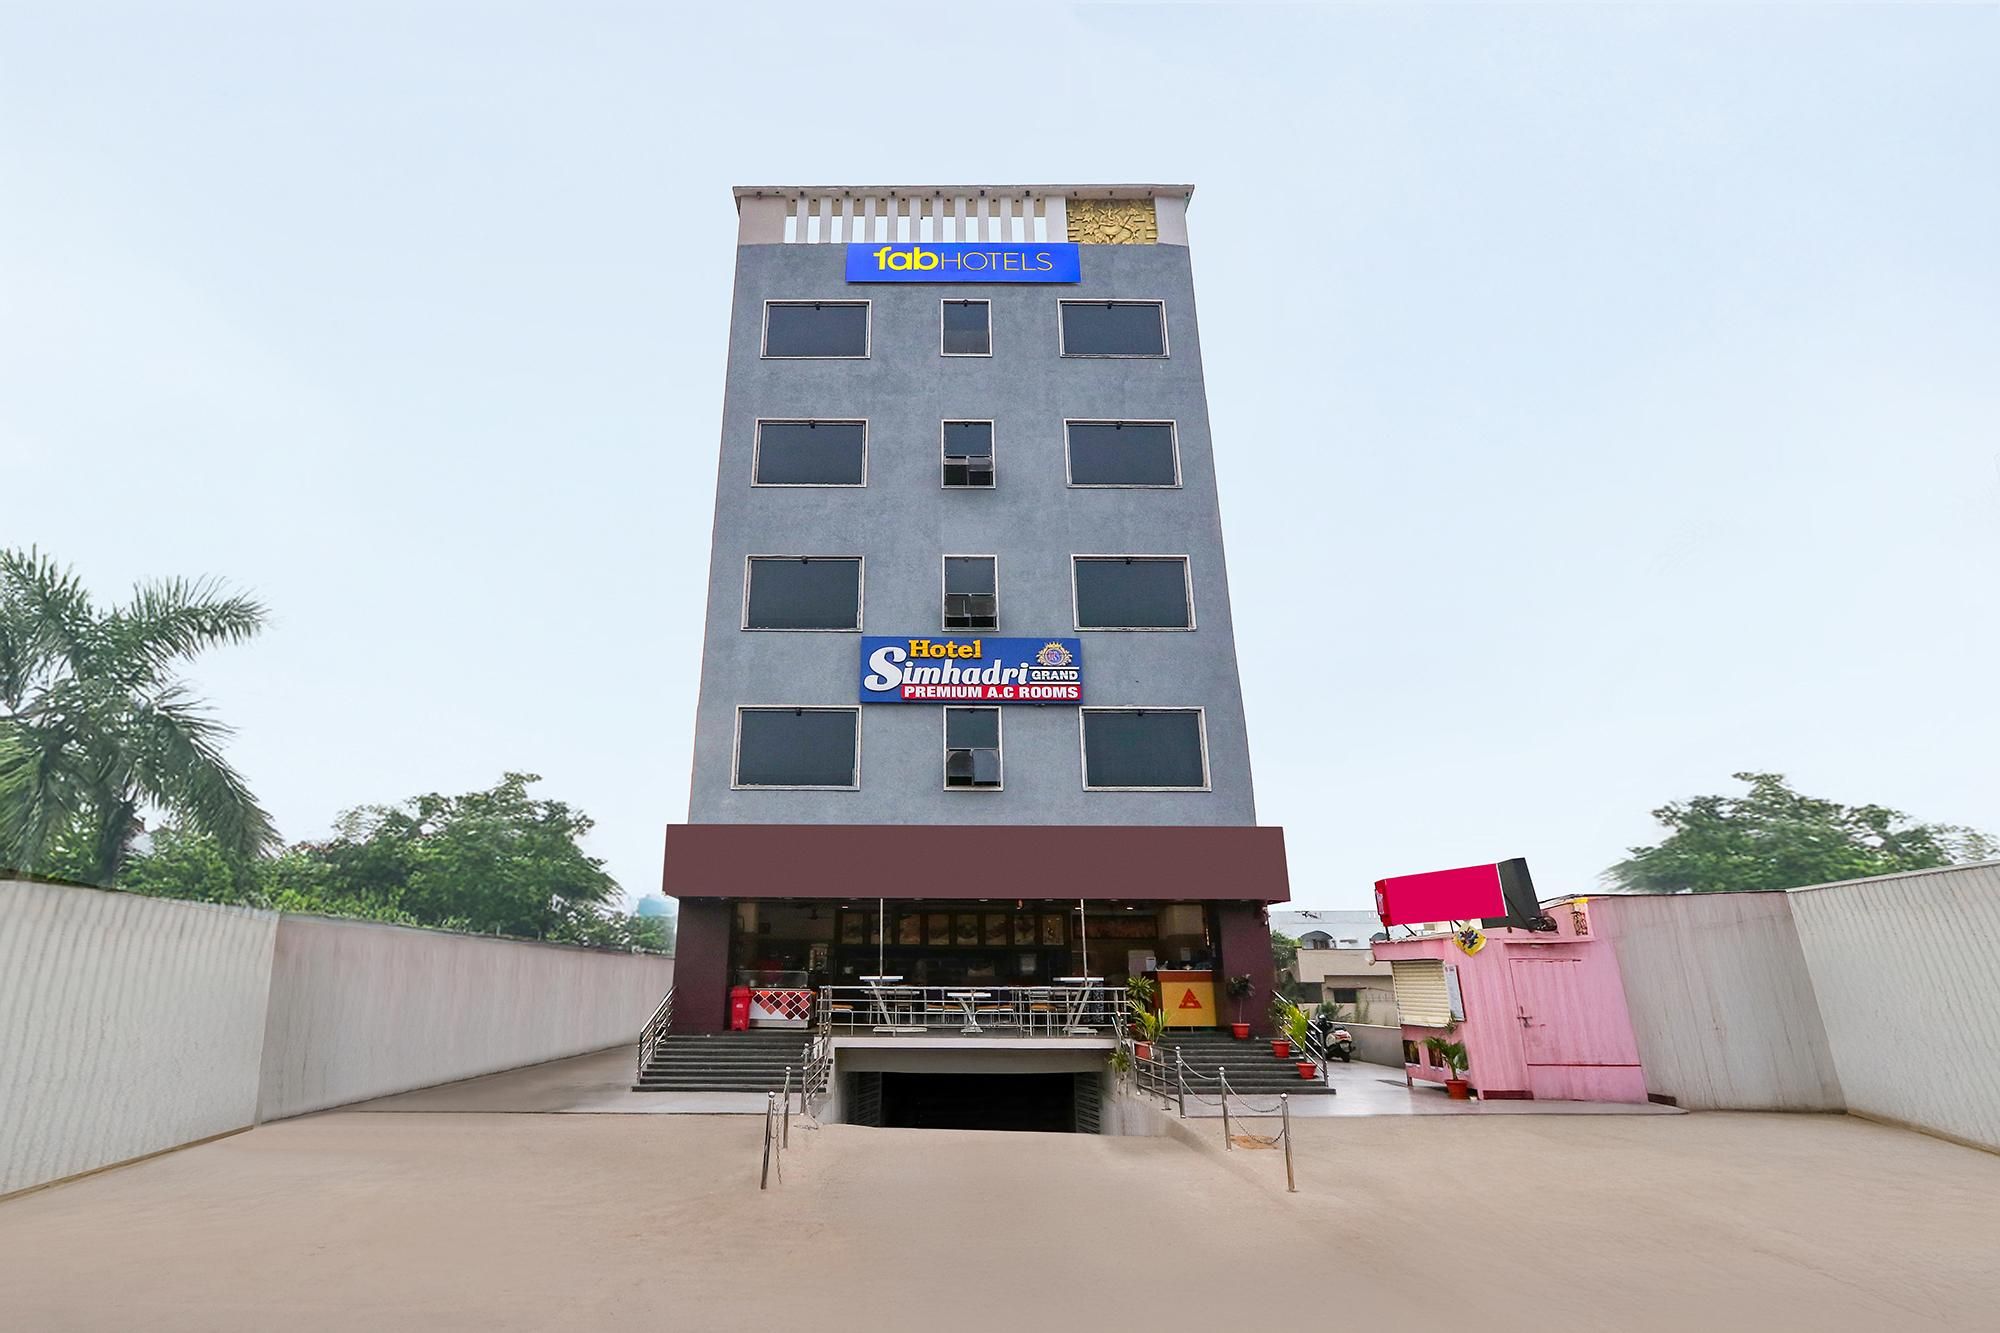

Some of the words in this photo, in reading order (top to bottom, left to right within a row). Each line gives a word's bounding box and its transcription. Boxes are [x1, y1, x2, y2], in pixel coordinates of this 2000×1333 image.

[908, 639, 981, 659] Hotel
[863, 646, 1030, 692] Simhadri
[1031, 669, 1079, 681] GRAND
[904, 685, 982, 698] PREMIUM
[986, 686, 1014, 698] A.C
[1018, 686, 1079, 698] ROOMS
